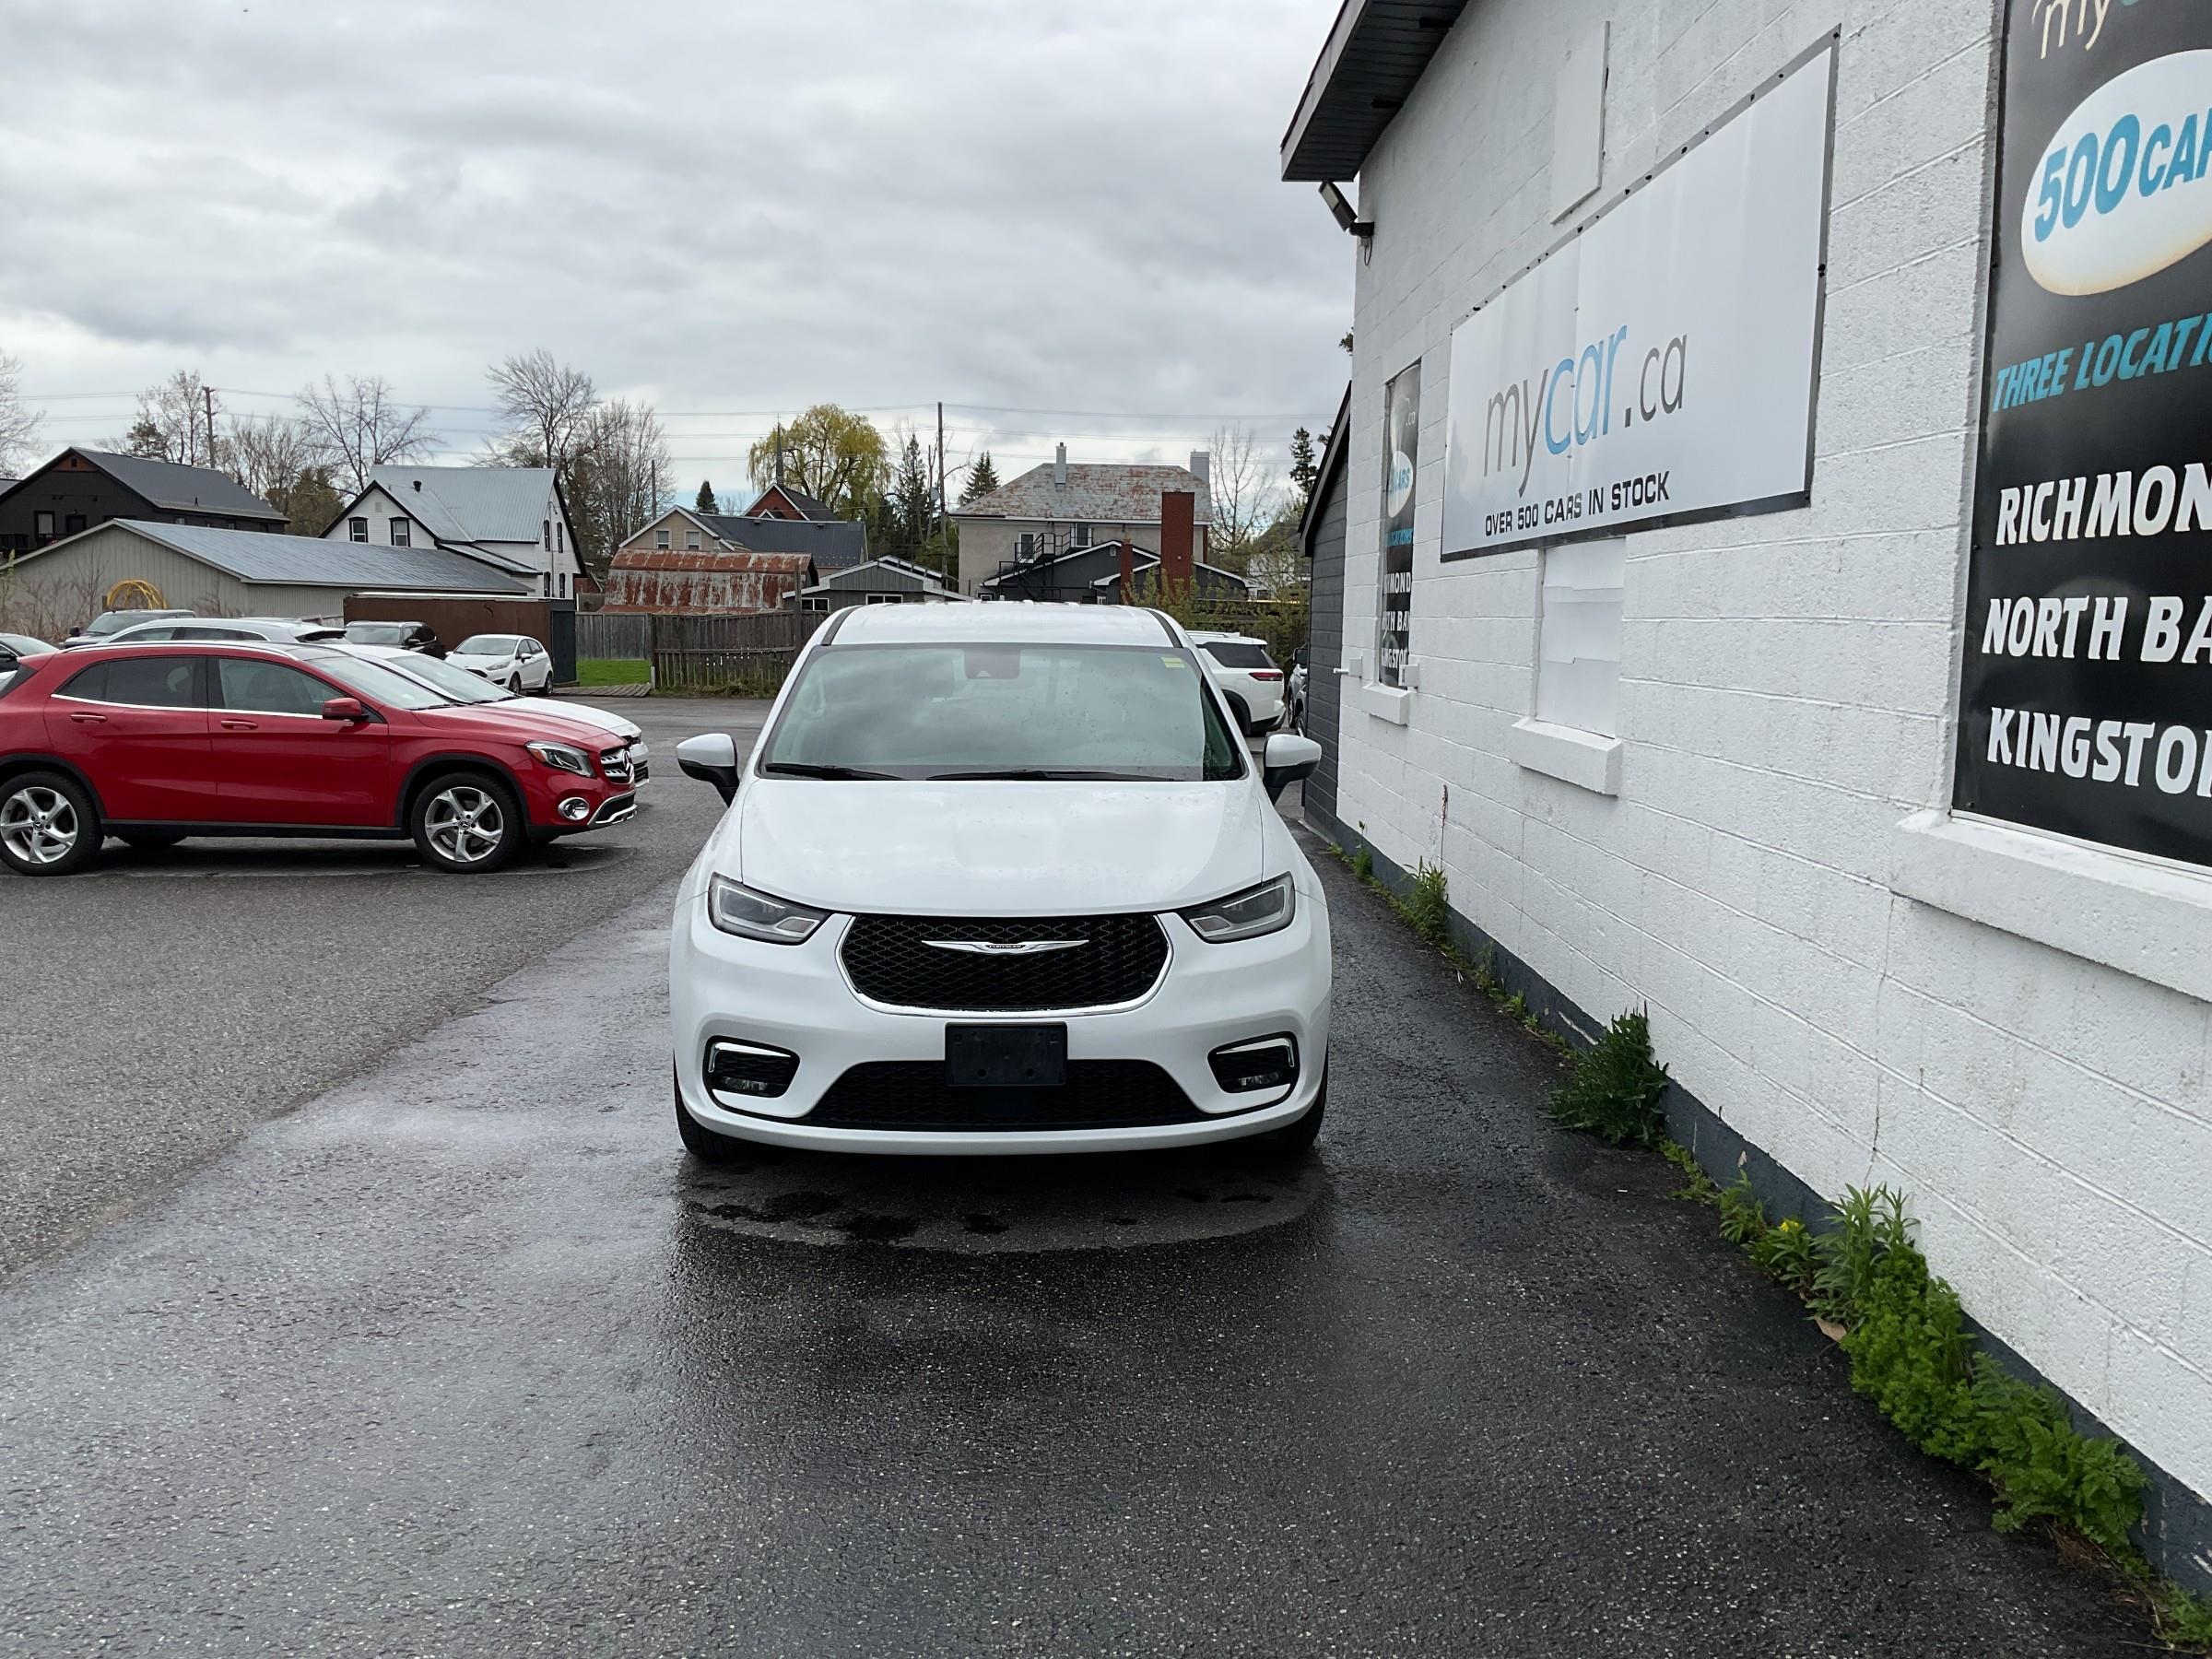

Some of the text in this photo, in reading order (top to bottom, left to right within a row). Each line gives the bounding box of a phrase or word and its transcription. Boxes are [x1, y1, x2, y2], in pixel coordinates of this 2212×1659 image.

[1992, 312, 2212, 413] THREE LOCATI
[1484, 324, 1687, 498] mycar.ca
[1485, 471, 1670, 536] OVER 500 CARS IN STOCK
[1982, 594, 2128, 661] NORTH
